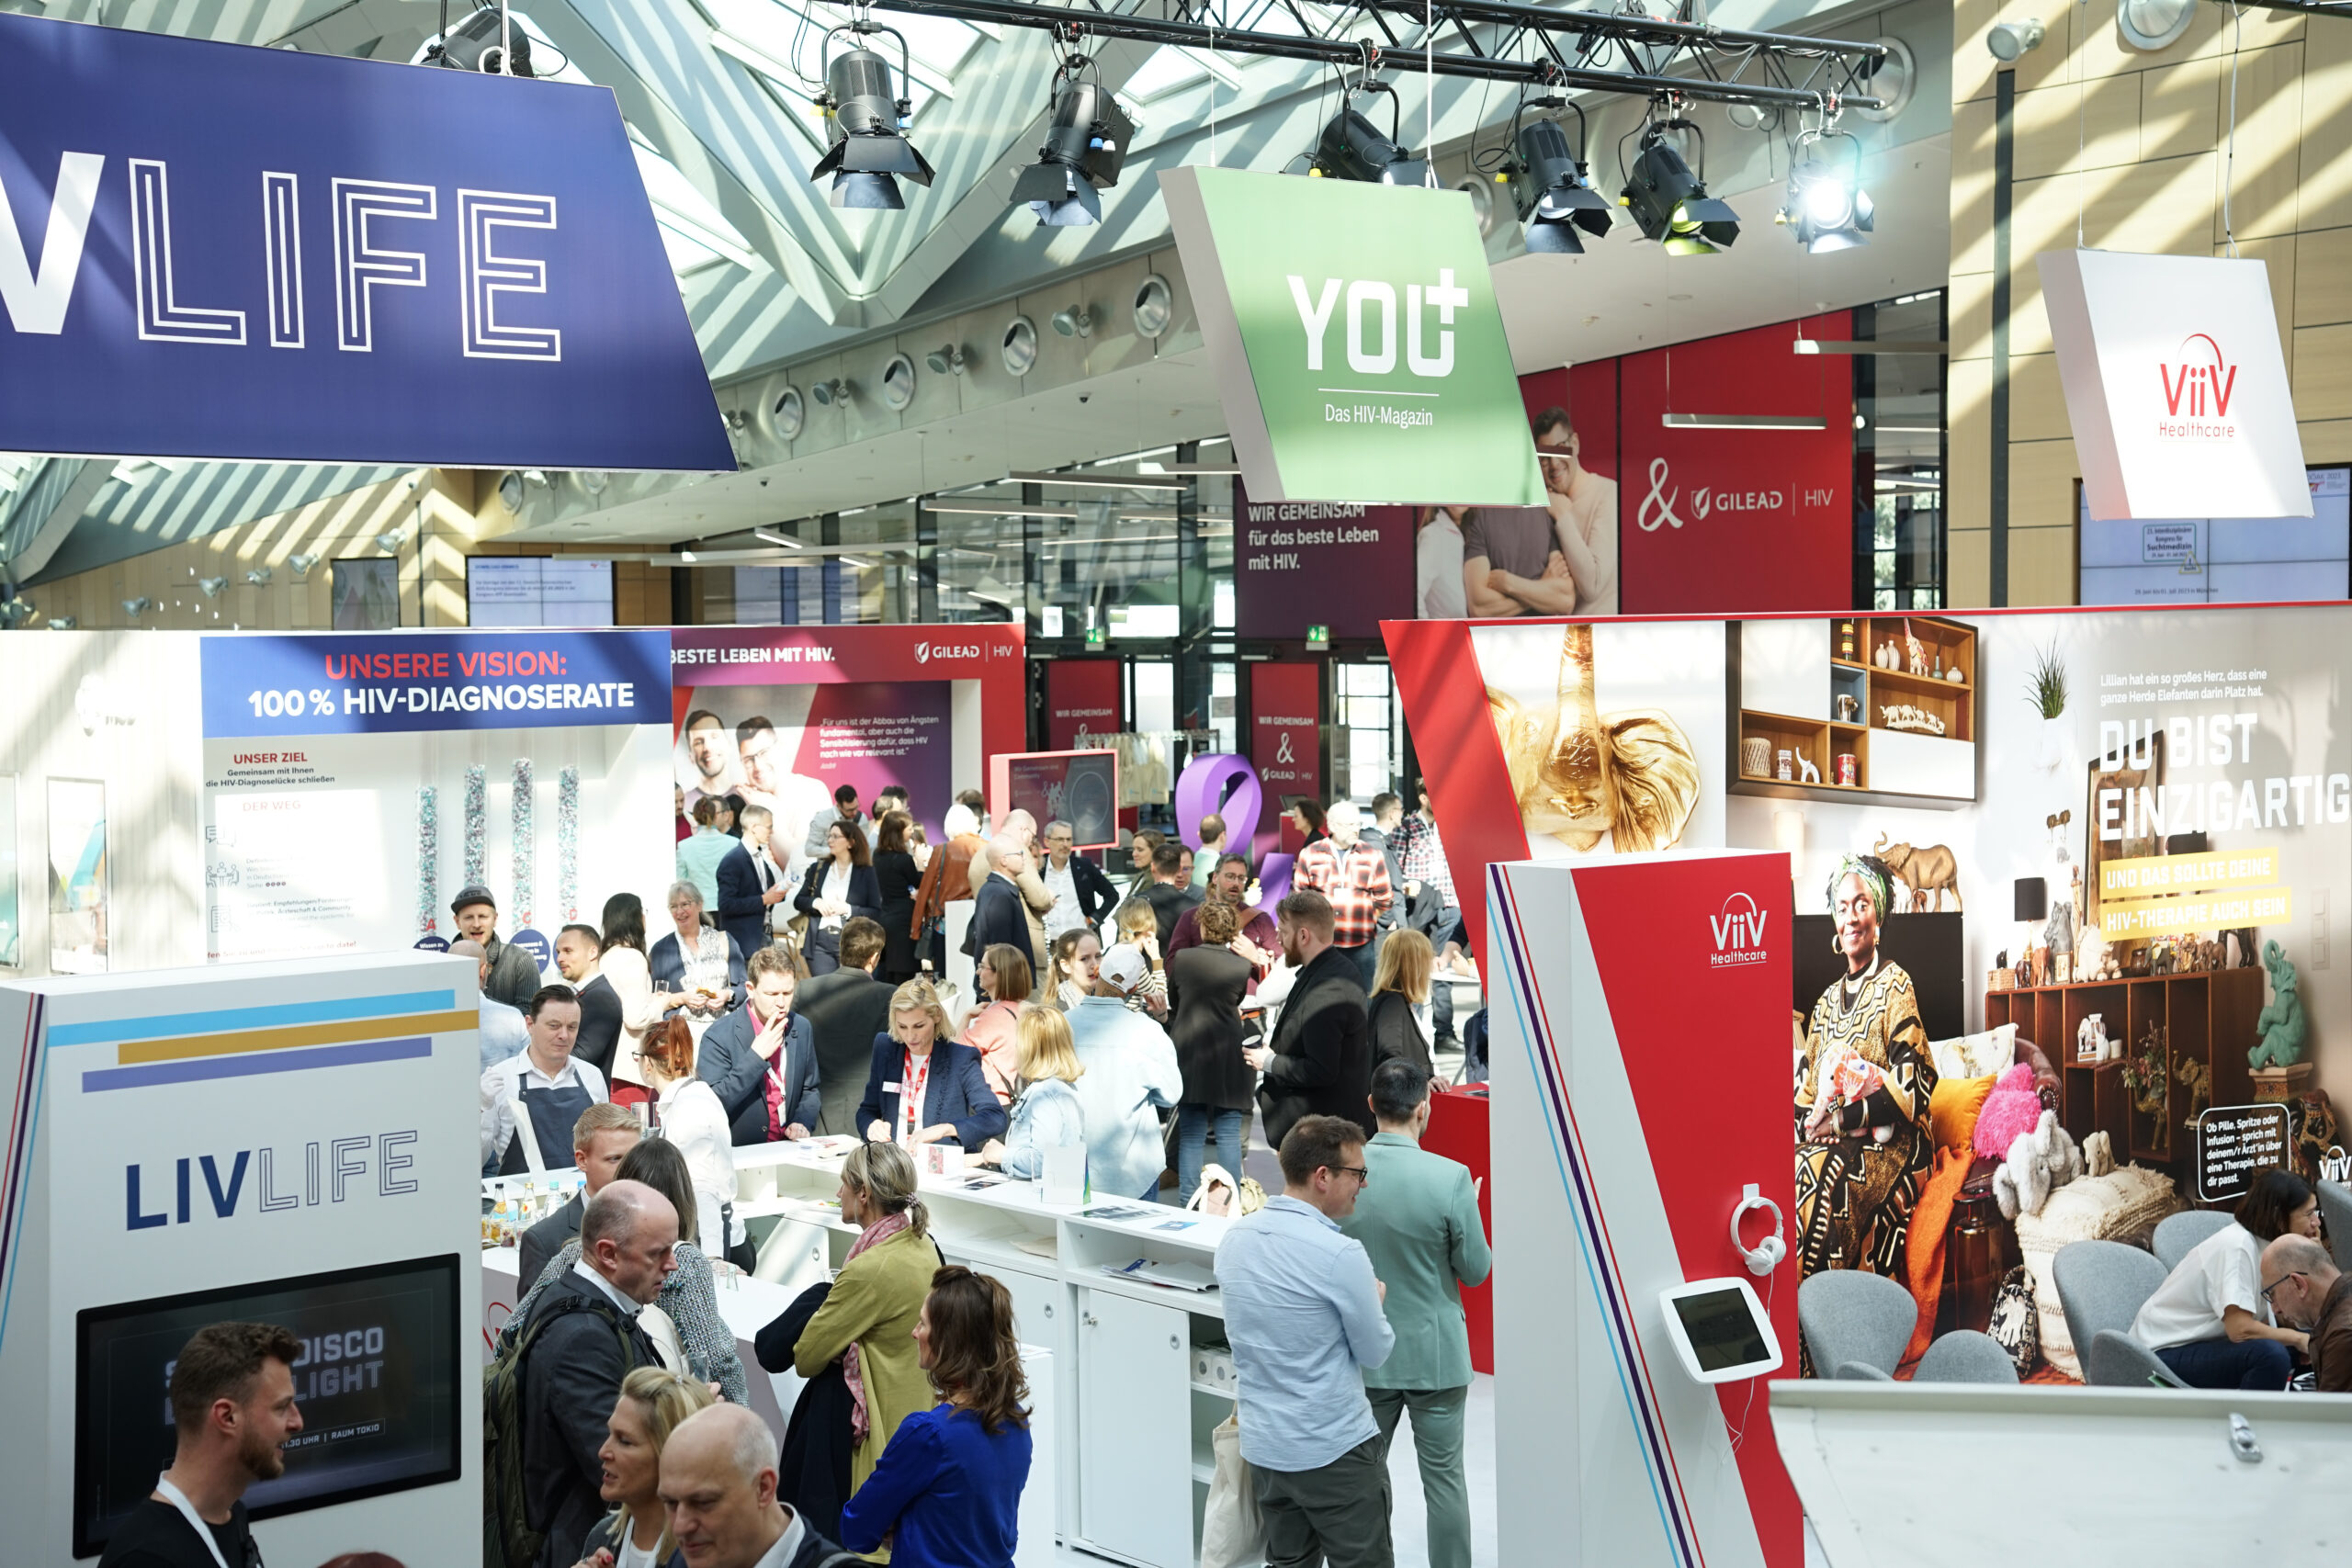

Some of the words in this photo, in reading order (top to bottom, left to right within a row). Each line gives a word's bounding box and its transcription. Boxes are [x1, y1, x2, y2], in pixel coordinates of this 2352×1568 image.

[2160, 363, 2237, 416] ViiV
[1325, 404, 1351, 423] Das
[1353, 405, 1433, 429] HIV-Magazin
[2159, 422, 2235, 437] Healthcare
[1715, 491, 1783, 512] GILEAD
[1804, 488, 1834, 507] HIV
[1248, 506, 1275, 523] WIR
[1279, 504, 1365, 521] GEMEINSAM
[1248, 529, 1267, 547] für
[1271, 529, 1295, 546] das
[1296, 527, 1334, 545] beste
[1338, 526, 1379, 544] Leben
[1248, 554, 1271, 570] mit
[1273, 553, 1301, 570] HIV.
[720, 649, 772, 663] LEBEN
[775, 647, 803, 663] MIT
[806, 647, 836, 662] HIV.
[932, 645, 980, 660] GILEAD
[993, 645, 1013, 658] HIV
[325, 653, 448, 681] UNSERE
[458, 650, 568, 677] VISION:
[2100, 674, 2128, 687] Lillian
[2129, 672, 2144, 685] hat
[2145, 672, 2159, 685] ein
[2160, 674, 2171, 684] so
[2173, 671, 2202, 687] großes
[2204, 670, 2226, 683] Herz,
[2227, 669, 2247, 682] dass
[2248, 669, 2267, 681] eine
[247, 689, 305, 717] 100
[309, 688, 335, 716] %
[344, 682, 634, 715] HIV-DIAGNOSERATE
[2100, 694, 2128, 706] ganze
[2129, 690, 2156, 704] Herde
[2158, 688, 2199, 702] Elefanten
[2201, 686, 2223, 700] darin
[2224, 685, 2246, 698] Platz
[2247, 684, 2264, 697] hat.
[849, 717, 859, 726] ist
[859, 716, 871, 725] der
[872, 716, 896, 725] Abbau
[910, 715, 939, 726] Ängsten
[1056, 709, 1070, 718] WIR
[1071, 708, 1114, 718] GEMEINSAM
[1258, 716, 1272, 725] WIR
[1273, 716, 1315, 726] GEMEINSAM
[820, 728, 867, 738] fundamental,
[867, 728, 885, 736] aber
[885, 727, 902, 736] auch
[903, 727, 915, 735] die
[820, 739, 876, 749] Sensibilisierung
[876, 738, 898, 747] dafür,
[898, 737, 915, 745] dass
[915, 736, 929, 745] HIV
[2099, 717, 2154, 773] DU
[2168, 712, 2258, 769] BIST
[233, 752, 277, 764] UNSER
[281, 751, 308, 762] ZIEL
[820, 750, 839, 759] nach
[839, 750, 853, 758] wie
[853, 750, 865, 758] vor
[865, 748, 895, 757] relevant
[227, 769, 275, 777] Gemeinsam
[277, 767, 290, 775] mit
[291, 766, 314, 774] Ihnen
[1270, 770, 1295, 780] GILEAD
[205, 780, 219, 788] die
[220, 778, 296, 788] HIV-Diagnoselücke
[298, 775, 335, 784] schließen
[242, 801, 268, 812] DER
[272, 800, 301, 811] WEG
[2099, 773, 2350, 842] EINZIGARTIG
[2107, 868, 2138, 890] UND
[2141, 864, 2171, 887] DAS
[2174, 860, 2226, 884] SOLLTE
[2229, 856, 2271, 879] DEINE
[522, 911, 532, 924] C
[2107, 903, 2208, 932] HIV-THERAPIE
[2210, 899, 2250, 921] AUCH
[2252, 897, 2286, 919] SEIN
[425, 919, 436, 931] A
[1709, 910, 1768, 951] ViiV
[1711, 950, 1767, 965] Healthcare
[2206, 1122, 2218, 1134] Ob
[2218, 1120, 2236, 1132] Pille,
[2236, 1117, 2262, 1131] Spritze
[2262, 1114, 2279, 1125] oder
[2206, 1135, 2235, 1147] Infusion
[2242, 1130, 2264, 1144] sprich
[2264, 1127, 2277, 1138] mit
[2207, 1146, 2241, 1160] deinem/r
[2266, 1141, 2282, 1152] über
[2207, 1162, 2222, 1174] eine
[2223, 1157, 2256, 1171] Therapie,
[2256, 1156, 2268, 1167] die
[2269, 1155, 2278, 1165] zu
[2318, 1156, 2352, 1182] ViiV
[126, 1129, 419, 1231] LIVLIFE
[2207, 1176, 2218, 1188] dir
[2218, 1173, 2239, 1188] passt.
[302, 1434, 320, 1446] UHR
[331, 1428, 355, 1440] RAUM
[356, 1424, 379, 1436] TOKIO
